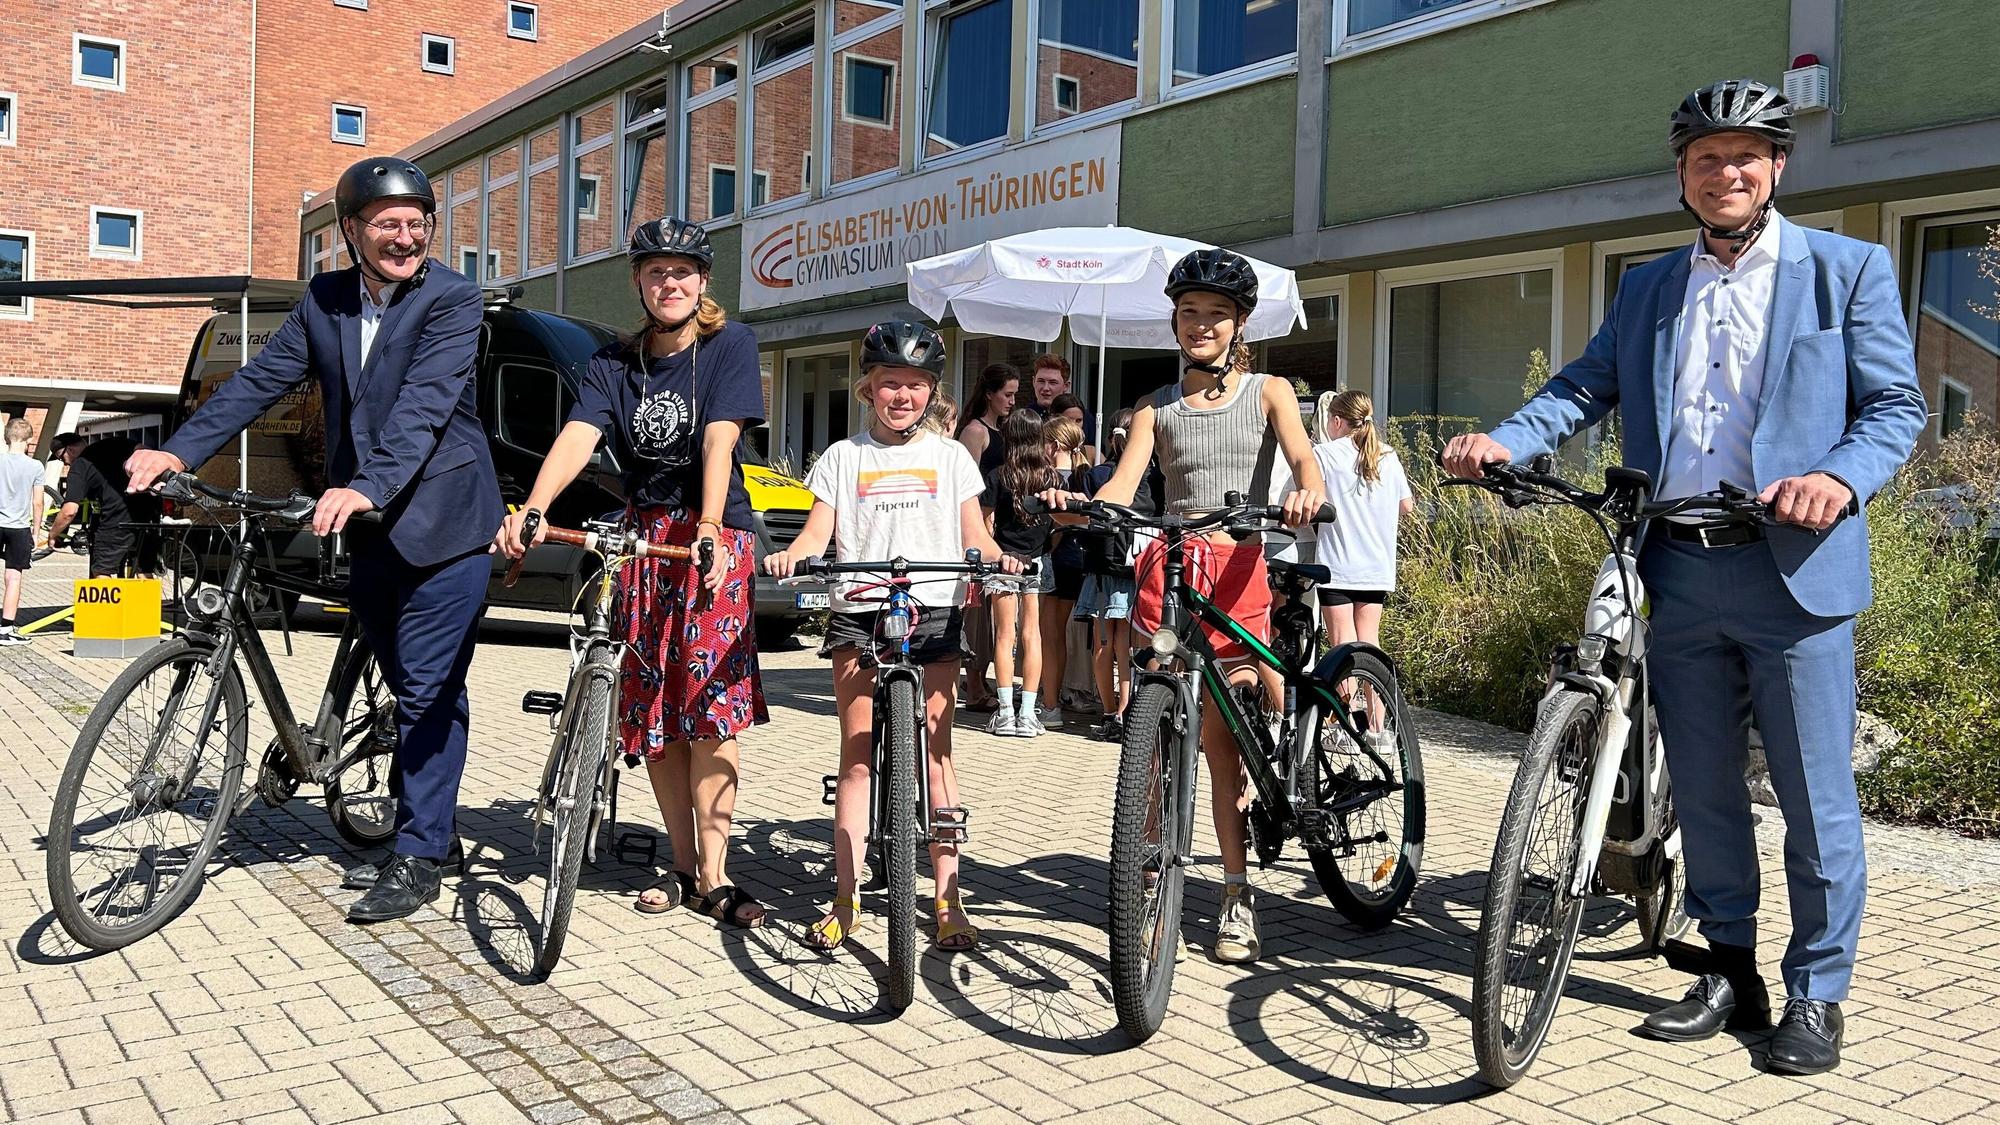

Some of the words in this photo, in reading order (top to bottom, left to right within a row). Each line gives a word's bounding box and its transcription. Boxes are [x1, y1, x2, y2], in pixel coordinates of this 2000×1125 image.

[796, 241, 894, 286] GYMNASIUM
[899, 229, 947, 266] KÖLN
[1056, 259, 1082, 269] Stadt
[1082, 260, 1103, 269] Köln
[654, 390, 671, 402] FOR
[249, 420, 299, 432] ORDRHEIN.DE
[77, 586, 121, 604] ADAC
